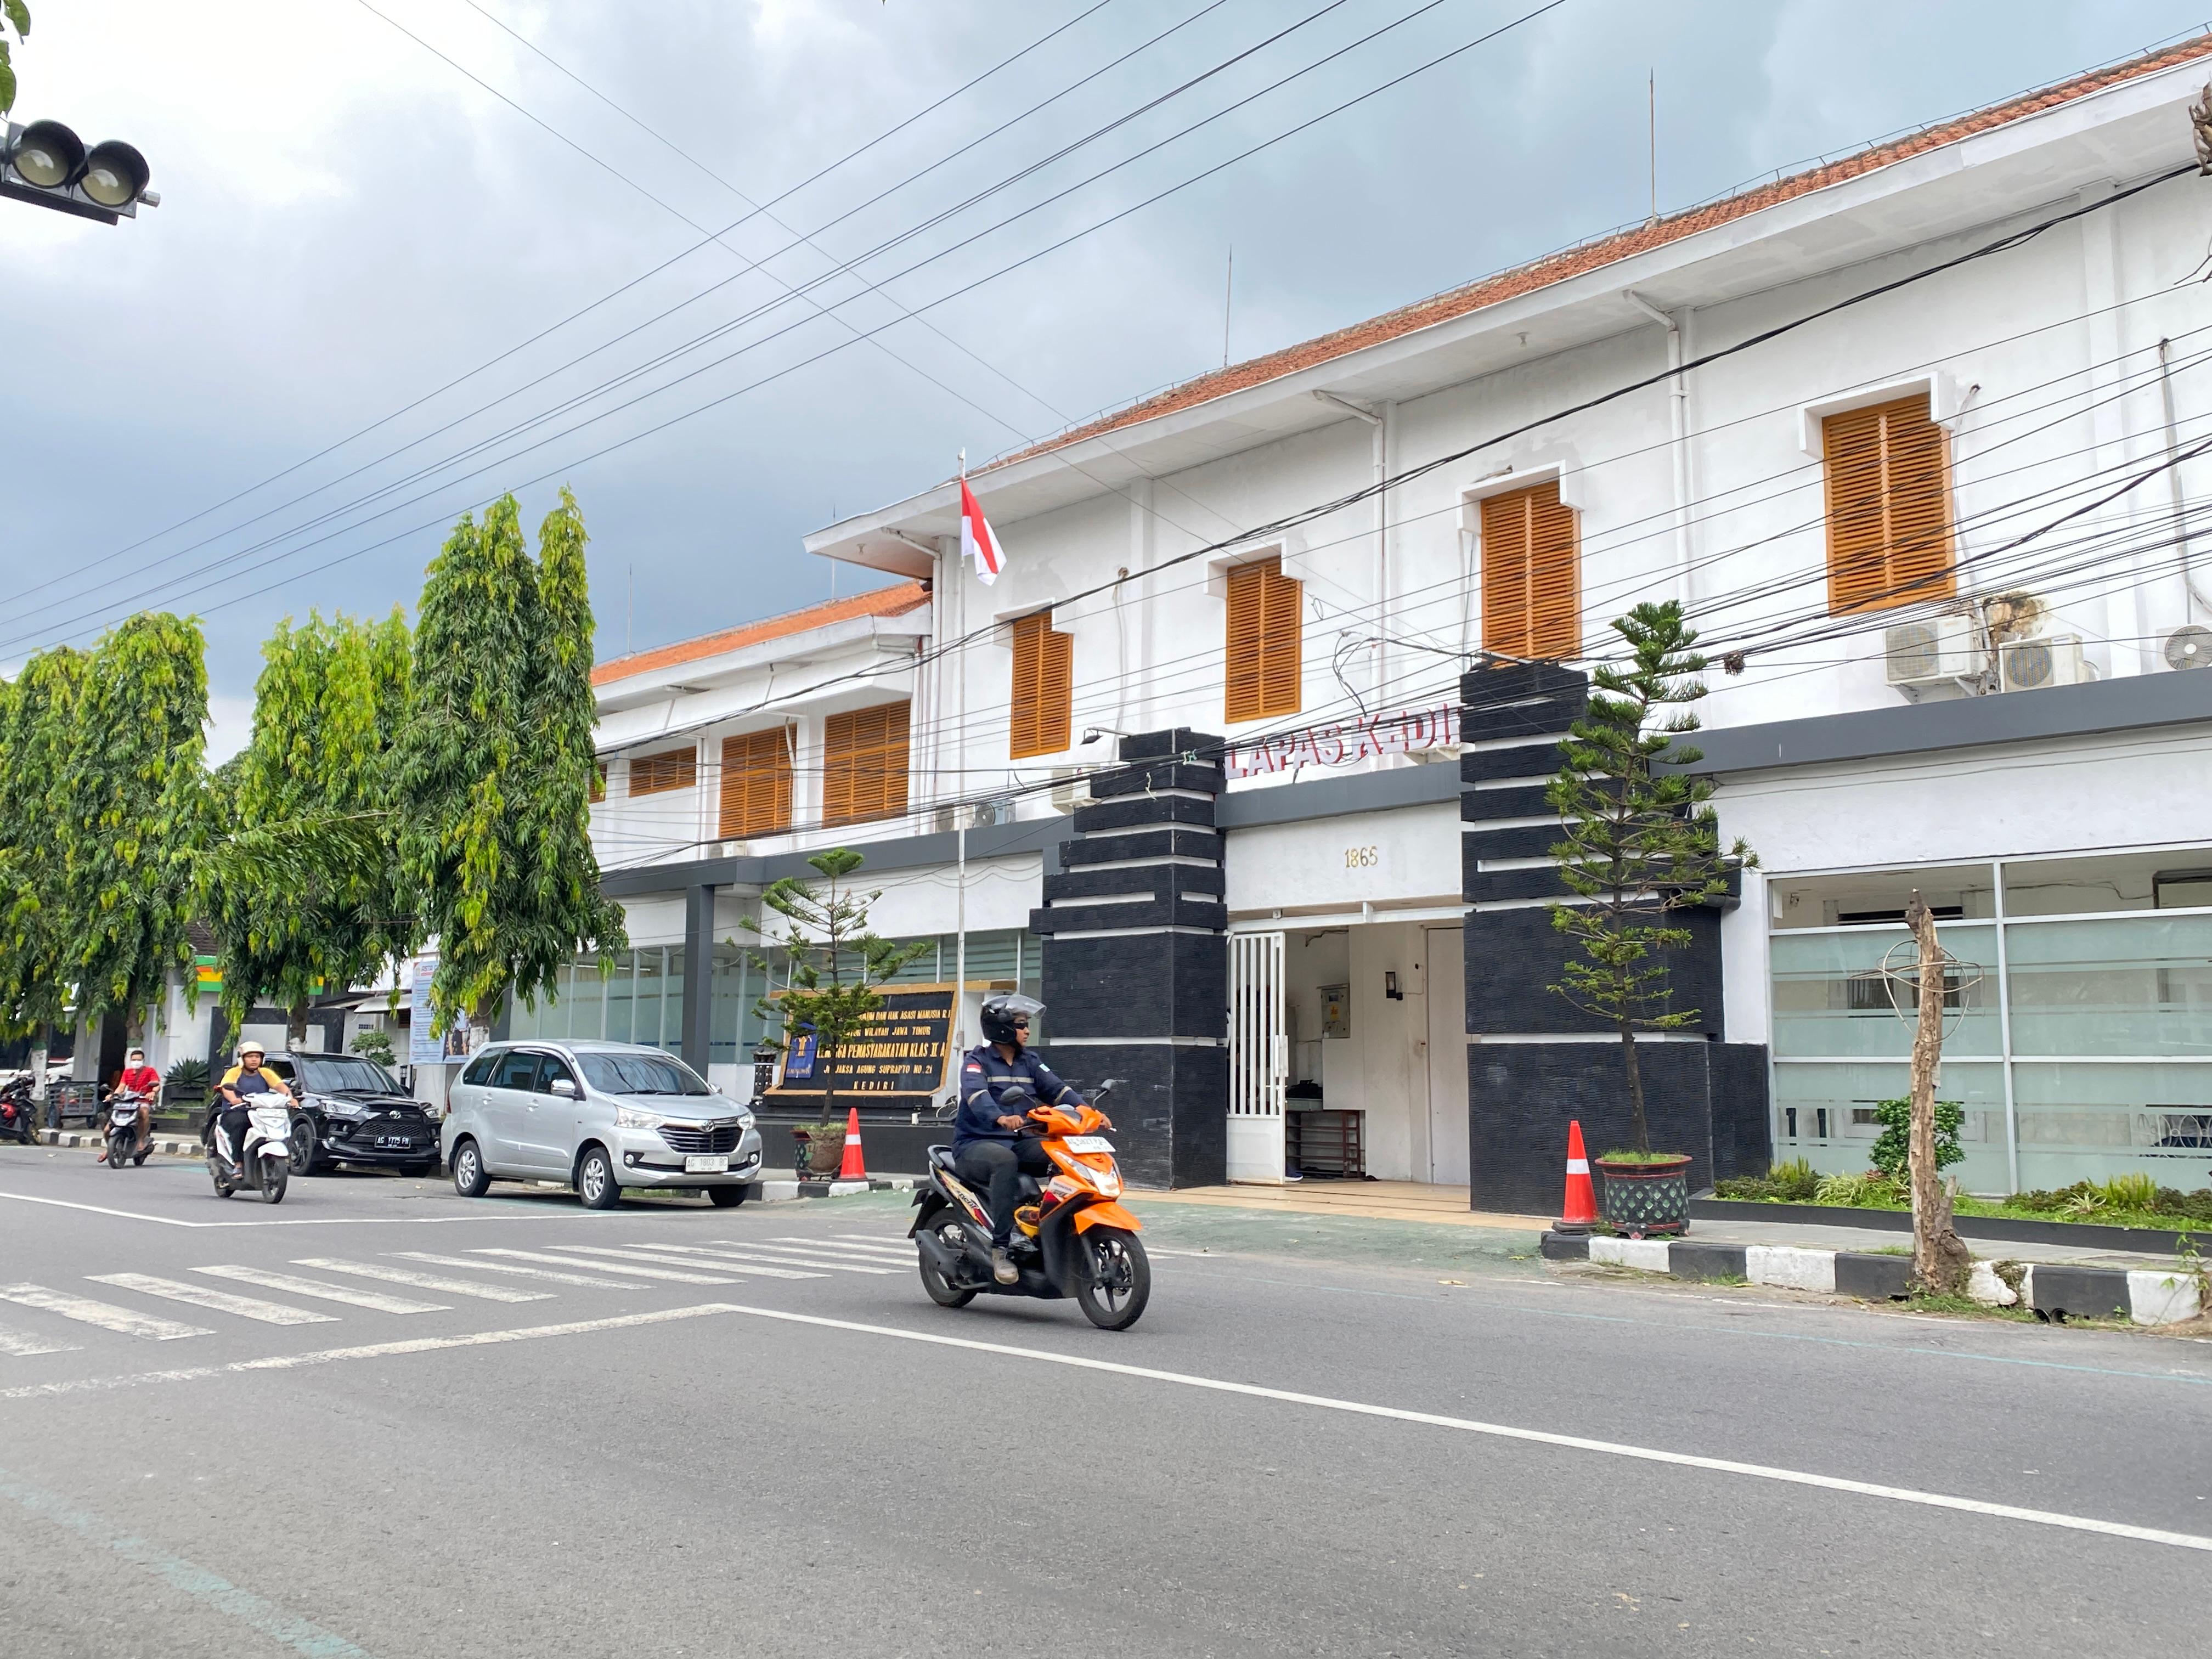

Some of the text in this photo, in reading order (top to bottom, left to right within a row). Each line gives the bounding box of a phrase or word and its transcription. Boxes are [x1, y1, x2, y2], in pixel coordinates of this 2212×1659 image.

[1225, 724, 1344, 780] LAPAS
[1345, 846, 1378, 868] 1865
[876, 1011, 887, 1020] DAN
[888, 1011, 899, 1020] HAK
[900, 1010, 917, 1020] ASASI
[917, 1009, 941, 1019] MANUSIA
[865, 1026, 889, 1036] WILAYAH
[892, 1026, 908, 1036] JAWA
[912, 1026, 931, 1036] TIMUR
[848, 1042, 909, 1058] PEMASYARAKATAN
[910, 1042, 929, 1058] KLAS
[940, 1042, 945, 1057] A
[835, 1064, 853, 1074] JAKSA
[856, 1064, 876, 1074] AGUNG
[879, 1064, 911, 1074] SUPRAPTO
[853, 1080, 894, 1091] KEDIRI
[687, 1157, 727, 1167] AG 1803 BC
